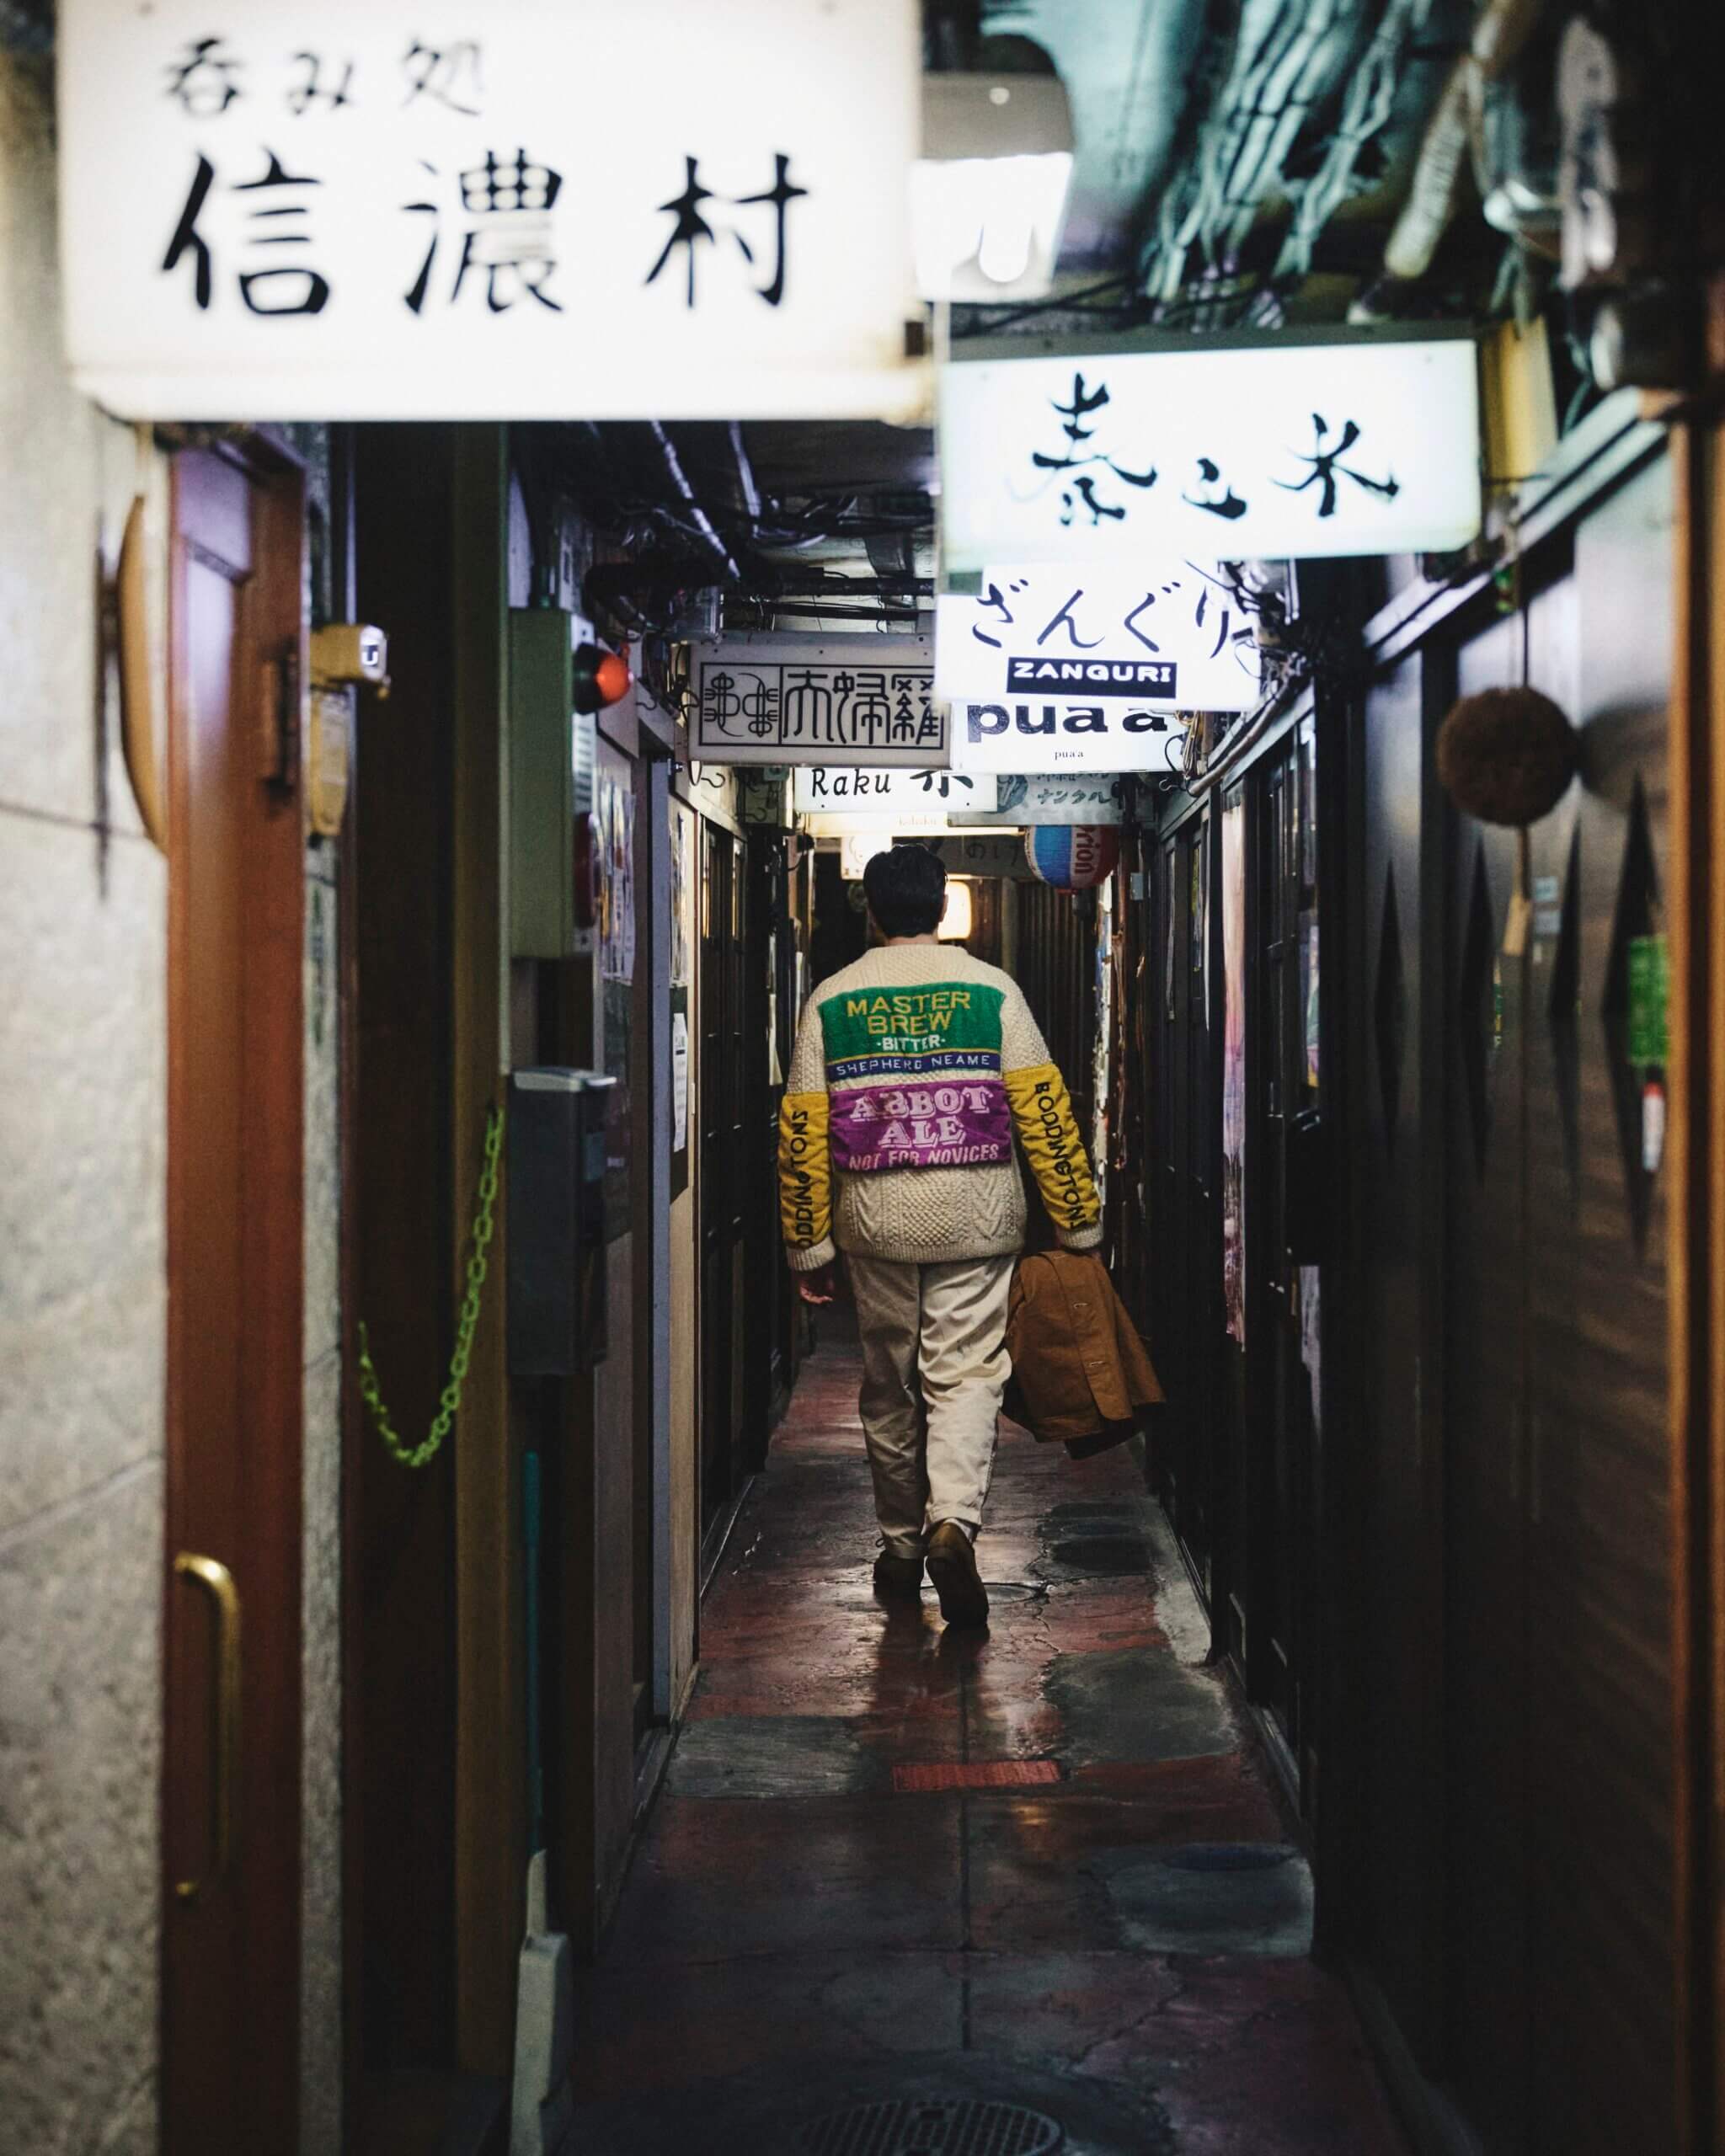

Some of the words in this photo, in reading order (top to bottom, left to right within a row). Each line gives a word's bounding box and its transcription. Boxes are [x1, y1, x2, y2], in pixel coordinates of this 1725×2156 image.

[165, 35, 483, 116] 呑み処
[161, 147, 809, 317] 信濃村
[973, 579, 1229, 659] ざんぐり
[1013, 661, 1172, 683] ZANGURI
[811, 767, 891, 798] Raku
[846, 991, 971, 1017] MASTER
[868, 1010, 953, 1035] BREW
[931, 1054, 991, 1067] NEAME
[850, 1086, 994, 1122] ABBOT
[878, 1115, 967, 1148] ALE
[848, 1152, 882, 1171] NOT
[889, 1150, 921, 1167] FOR
[927, 1144, 1000, 1165] NOVICES
[789, 1111, 814, 1249] ODDINGTONS
